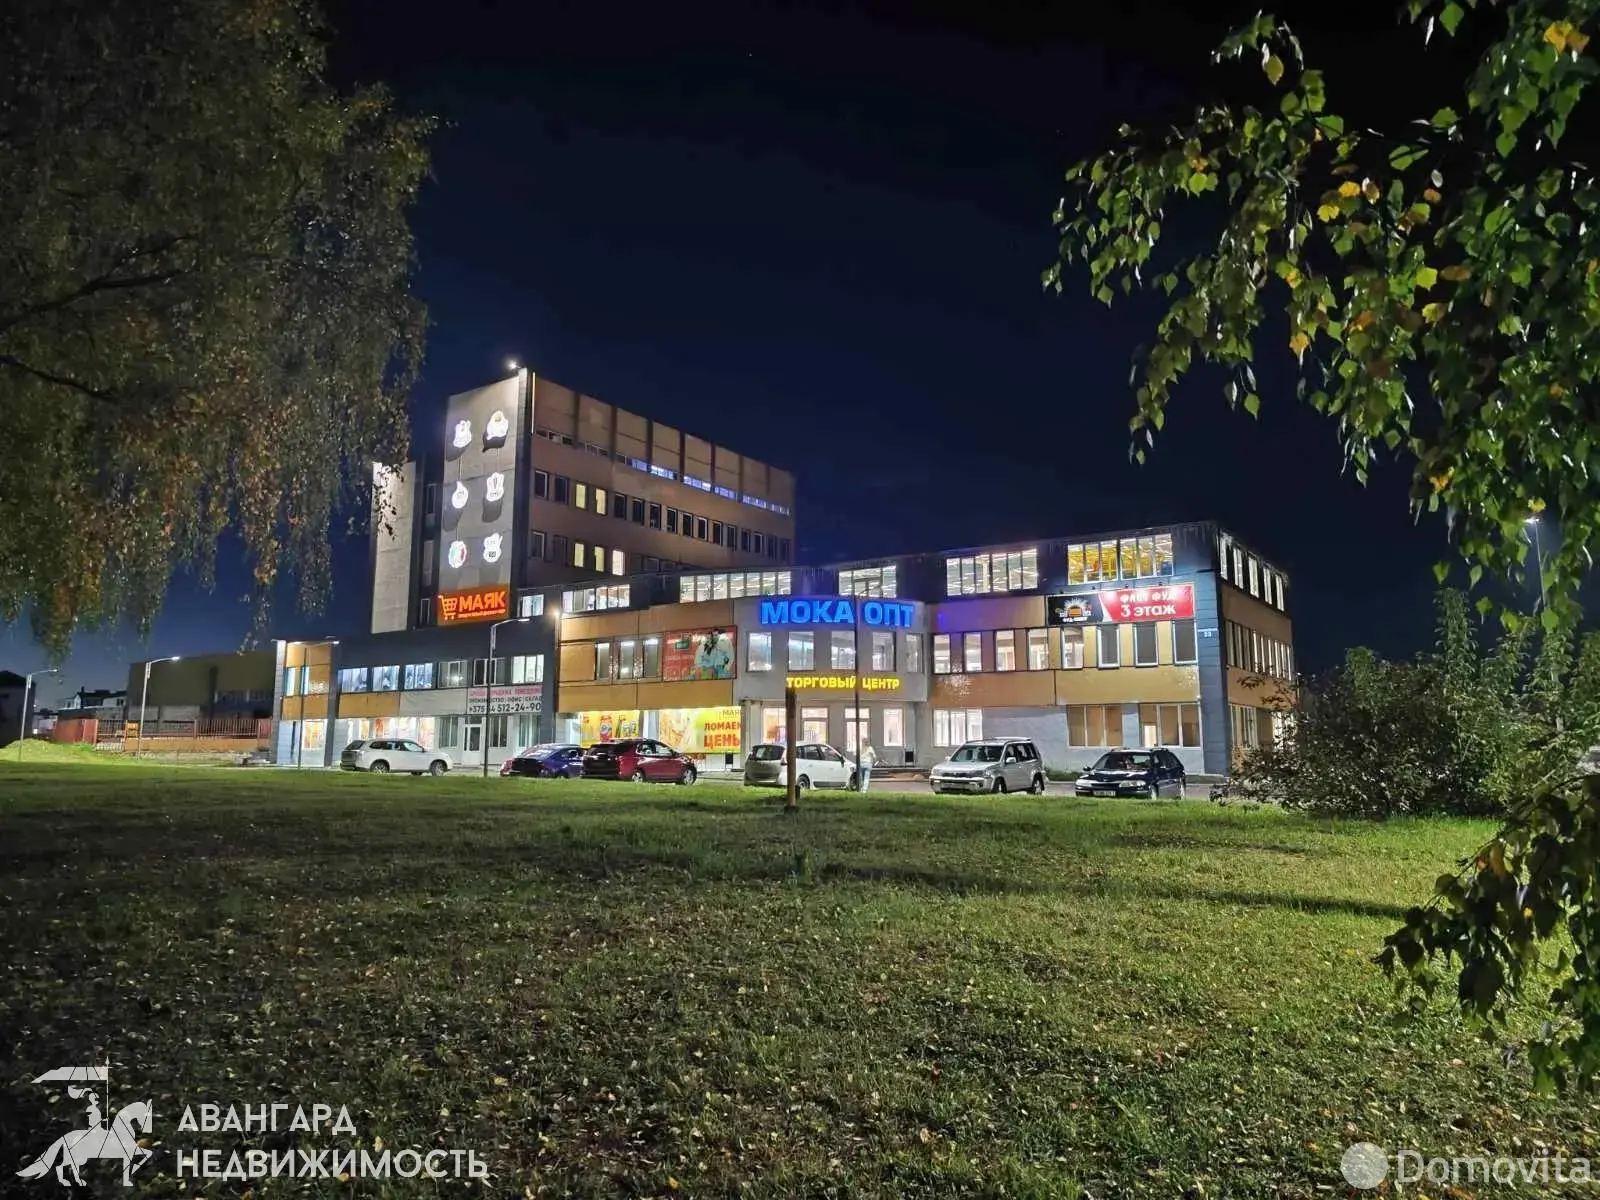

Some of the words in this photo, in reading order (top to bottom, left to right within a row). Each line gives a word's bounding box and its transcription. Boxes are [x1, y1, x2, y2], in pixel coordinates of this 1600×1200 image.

[459, 591, 506, 612] МАЯК
[761, 601, 854, 624] МОКА
[864, 602, 914, 627] ОПТ
[1120, 604, 1131, 617] 3
[1133, 604, 1176, 616] этаж
[786, 676, 856, 689] ТОРГОВЫЙ
[862, 677, 900, 690] ЦЕНТР
[469, 705, 485, 713] +375
[497, 702, 541, 712] 512-24-90
